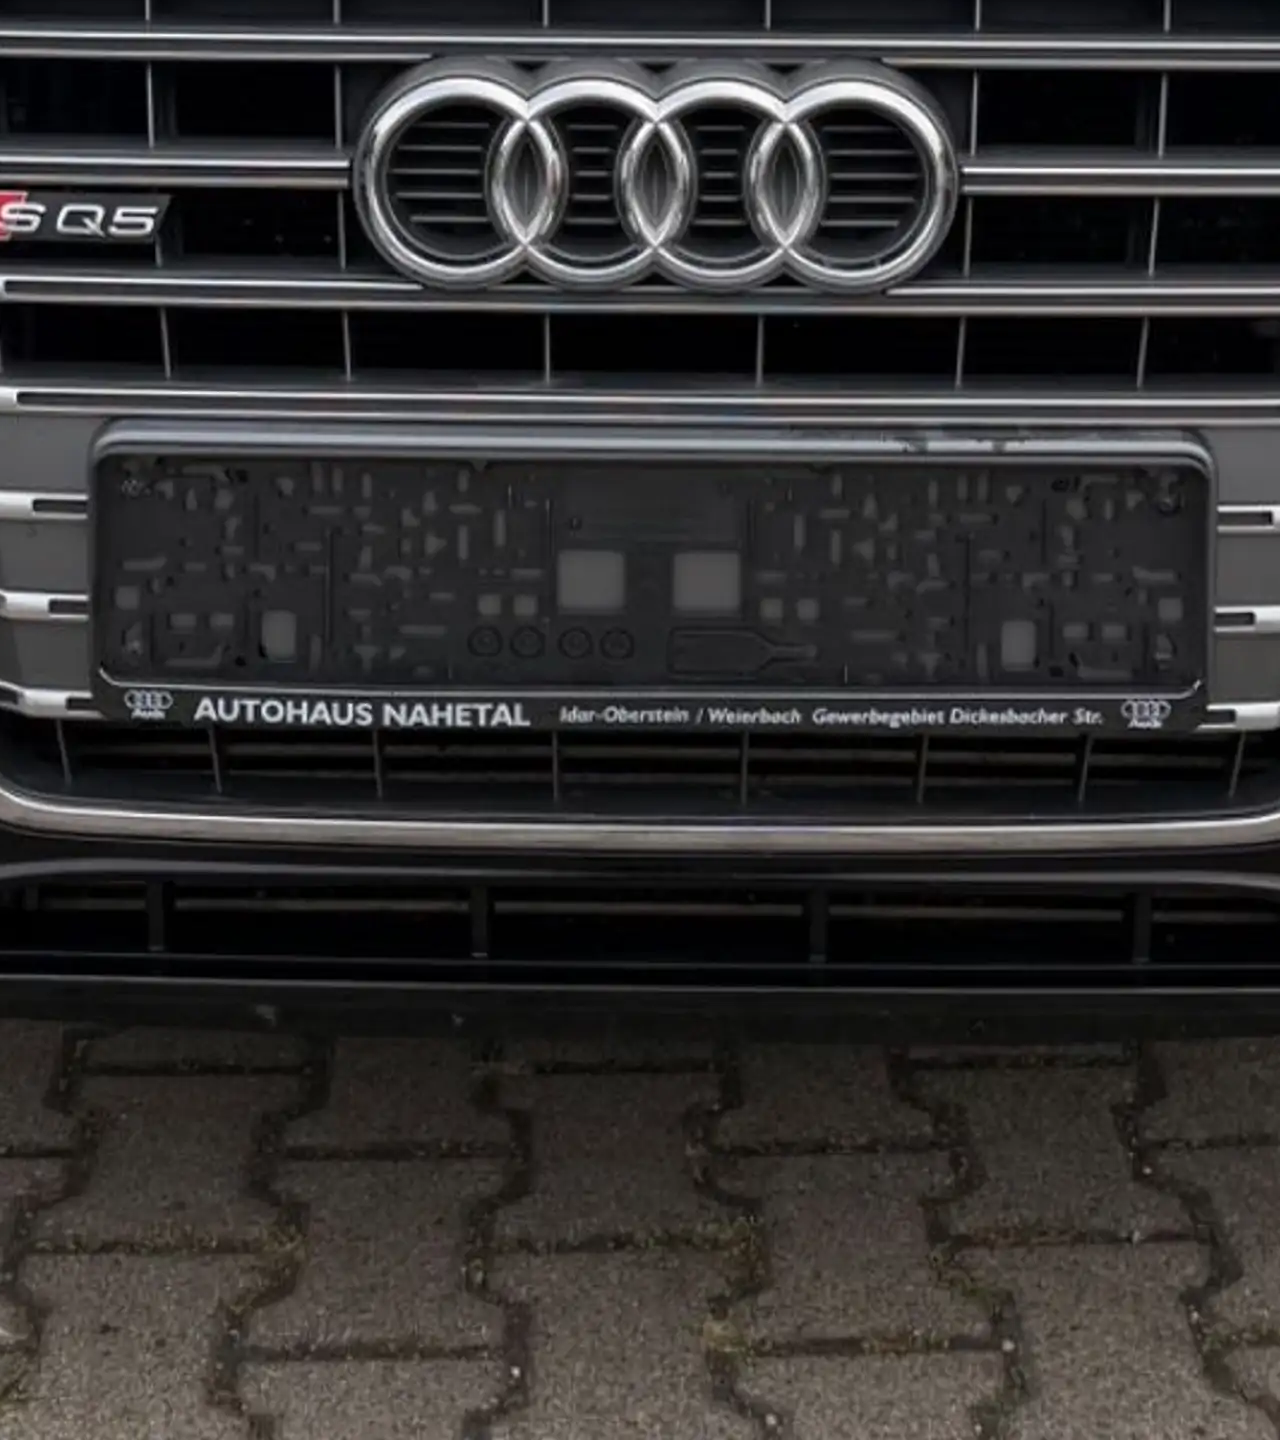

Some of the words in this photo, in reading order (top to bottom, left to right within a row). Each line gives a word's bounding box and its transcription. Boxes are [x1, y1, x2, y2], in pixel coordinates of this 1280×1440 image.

[194, 697, 373, 726] AUTOHAUS
[382, 702, 531, 727] NAHETAL
[559, 705, 690, 723] Idar-Oberstein
[707, 707, 801, 724] Weierbach
[812, 708, 945, 728] Gewerbegebiet
[1073, 707, 1103, 725] Str.
